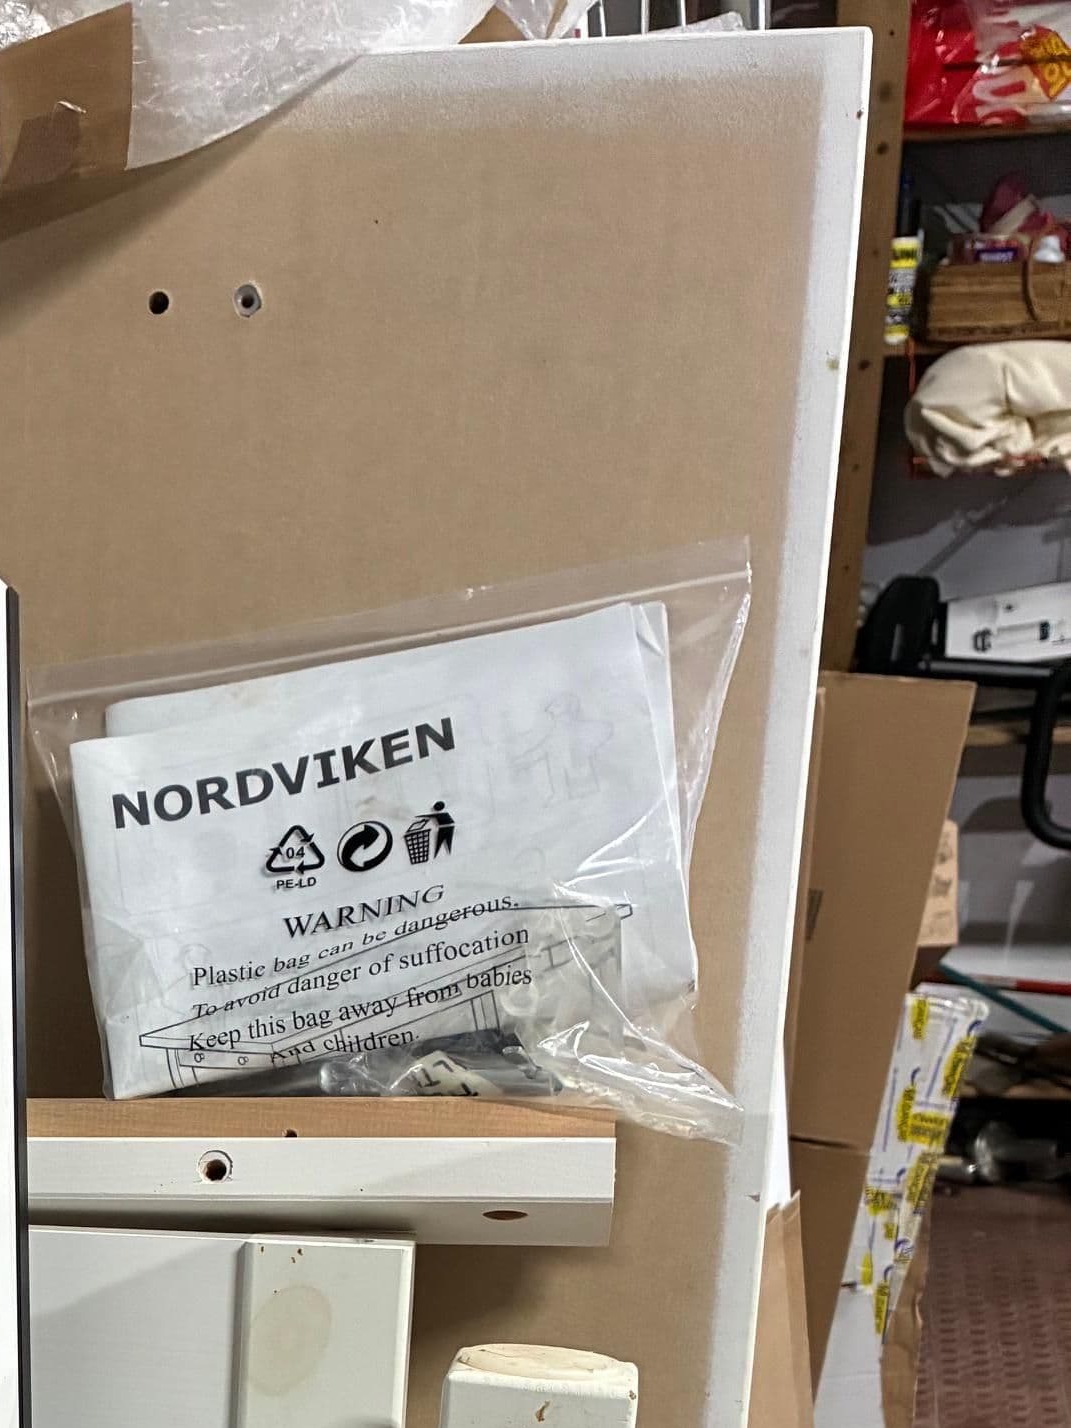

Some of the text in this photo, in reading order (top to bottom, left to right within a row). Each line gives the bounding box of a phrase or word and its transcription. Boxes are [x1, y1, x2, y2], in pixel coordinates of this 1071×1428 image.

[111, 717, 456, 829] NORDVIKEN
[275, 876, 317, 890] PE-LD
[285, 846, 306, 860] 04
[193, 894, 521, 986] Plastic bag can be dangerous.
[283, 883, 446, 939] WARNING
[187, 963, 534, 1053] Keep this bag away from babies
[192, 926, 531, 1021] To avoid danger of suffocation
[270, 1026, 421, 1065] And children.
